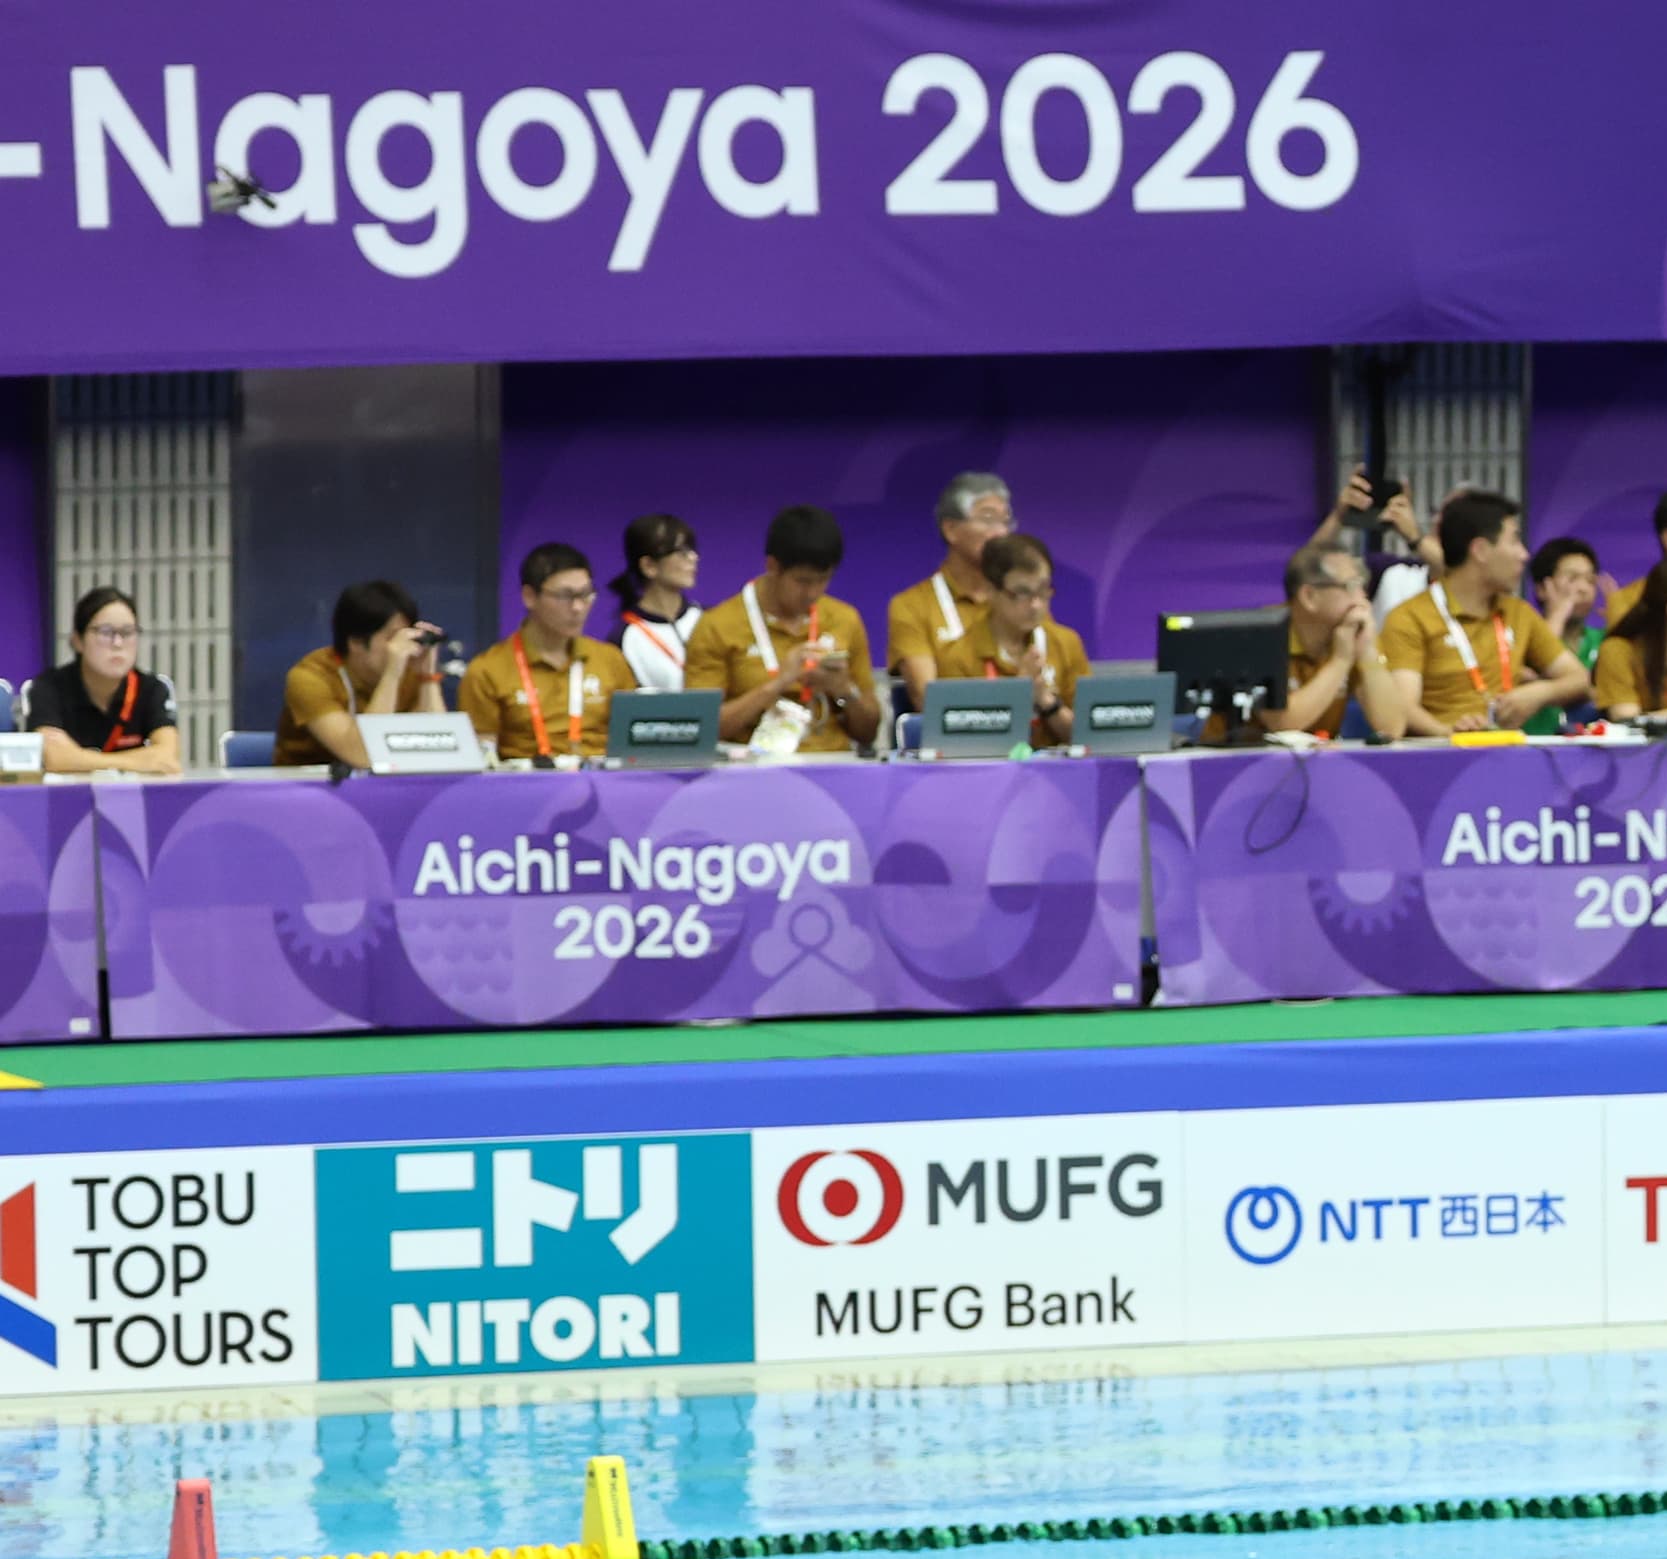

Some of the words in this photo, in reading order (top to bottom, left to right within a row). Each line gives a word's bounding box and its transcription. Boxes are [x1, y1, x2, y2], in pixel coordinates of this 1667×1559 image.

[881, 50, 1360, 217] 2026
[413, 832, 853, 908] Aichi-Nagoya
[553, 903, 713, 961] 2026
[72, 1171, 256, 1232] TOBU
[390, 1143, 679, 1271] ニトリ
[926, 1152, 1164, 1226] MUFG
[73, 1243, 208, 1302] TOP
[815, 1284, 984, 1337] MUFG
[1004, 1276, 1137, 1328] Bank
[74, 1308, 294, 1370] TOURS
[391, 1291, 680, 1369] NITORI
